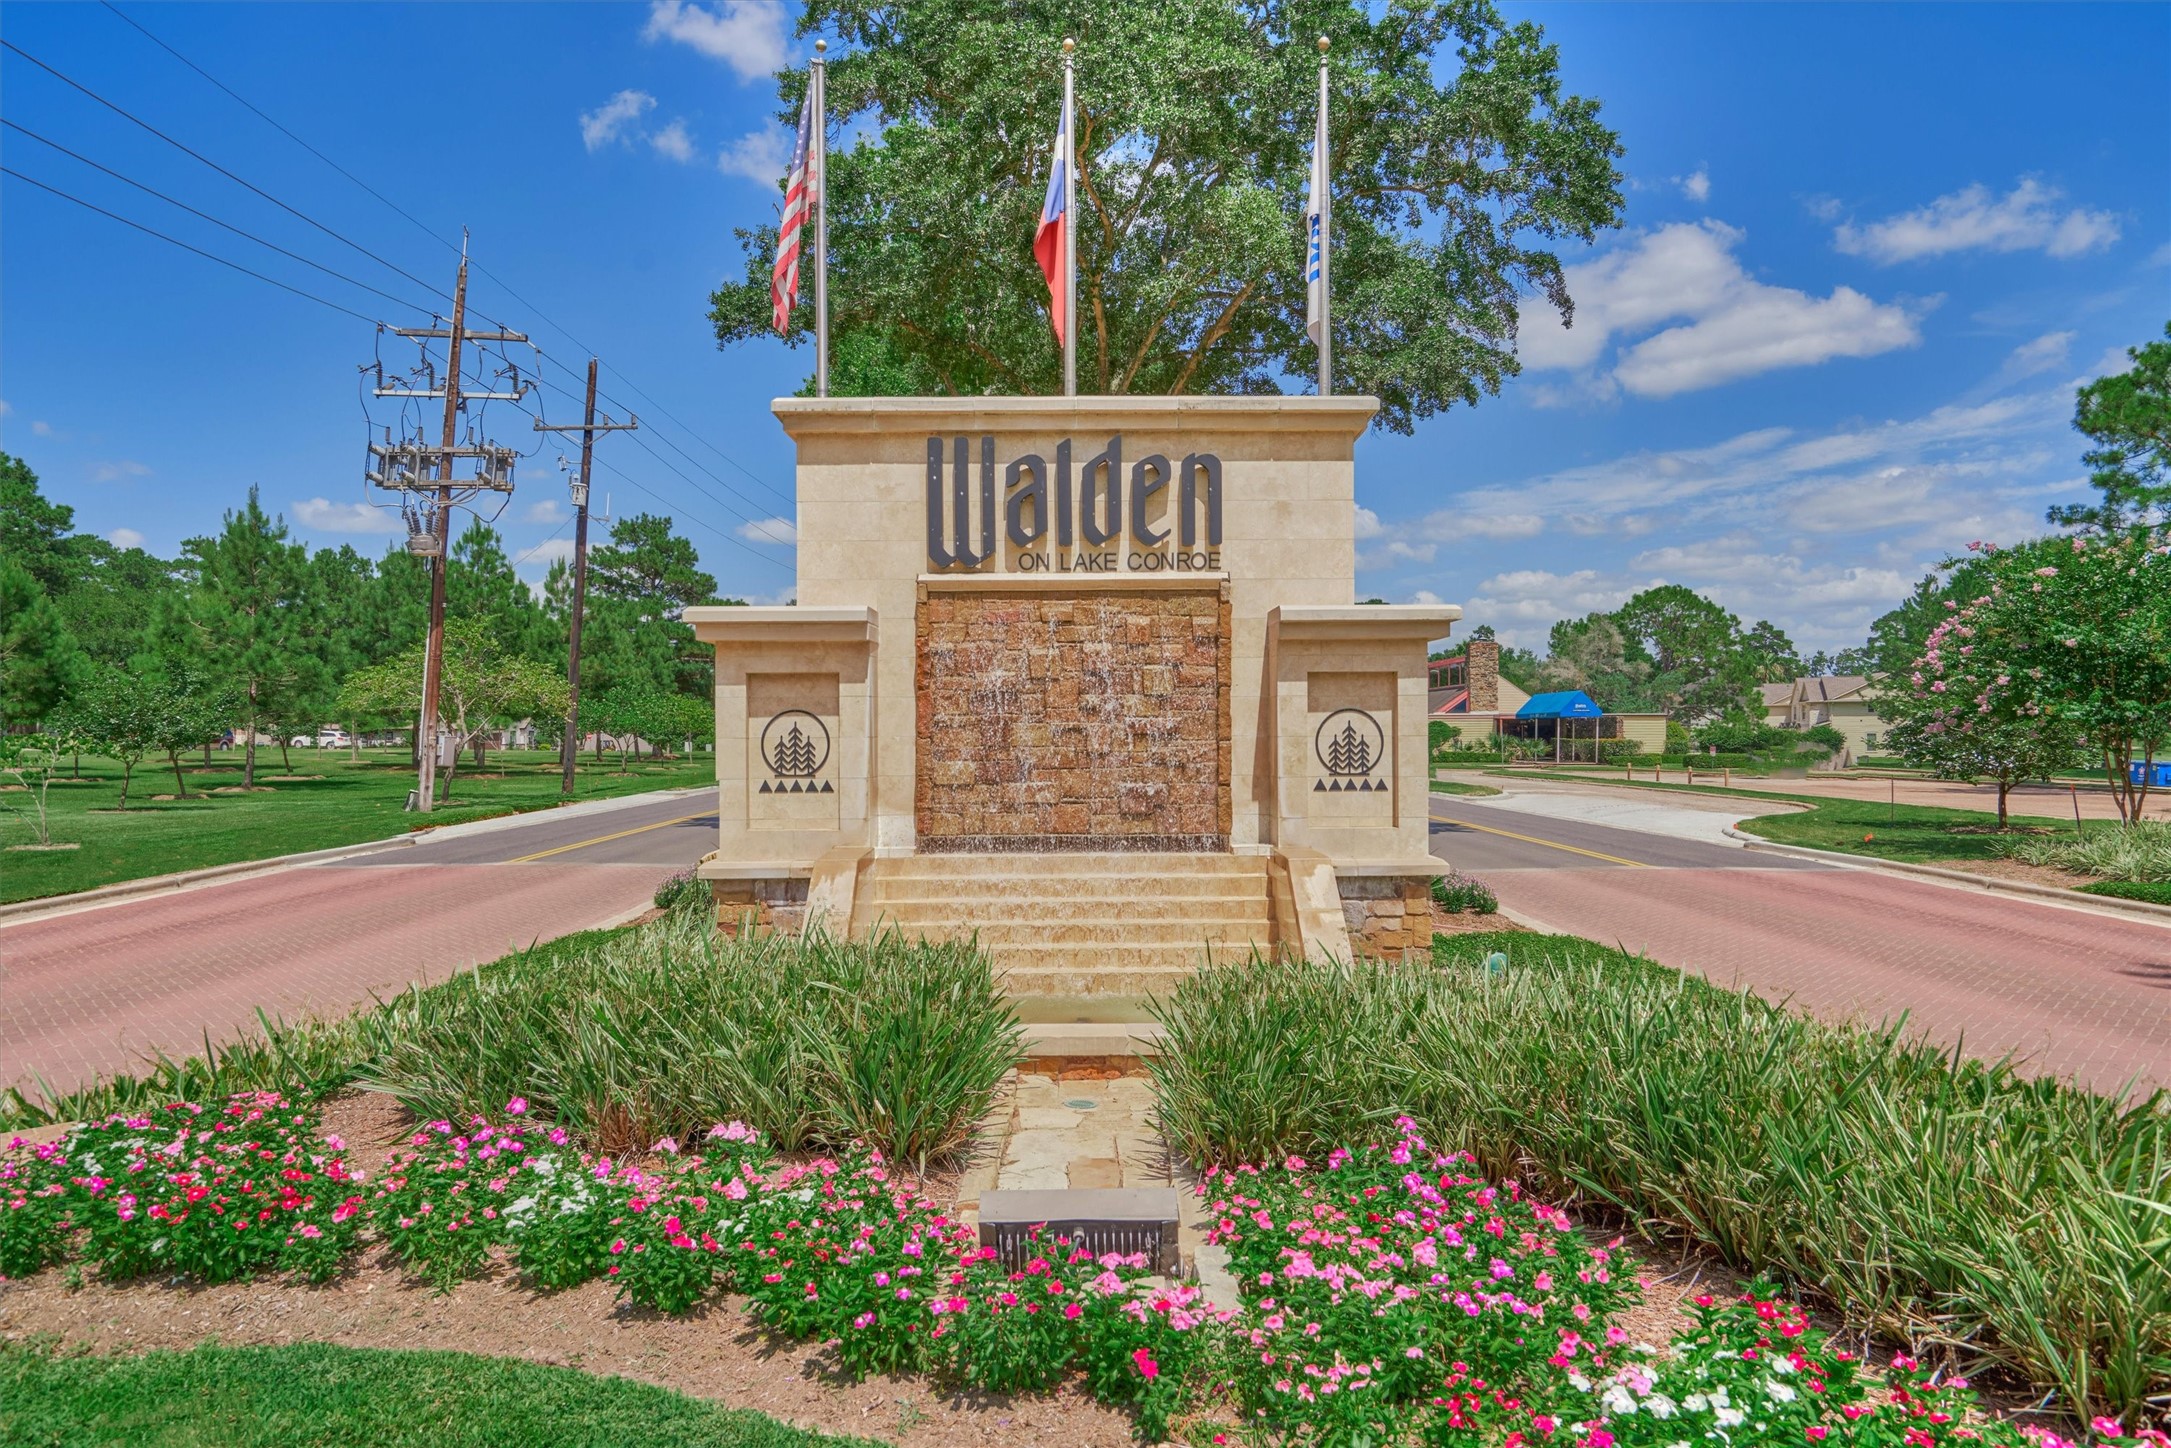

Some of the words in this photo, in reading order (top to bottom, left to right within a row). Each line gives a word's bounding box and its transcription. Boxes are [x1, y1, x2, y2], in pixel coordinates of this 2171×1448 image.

[927, 435, 1222, 568] Walden
[1018, 552, 1050, 571] ON
[1060, 552, 1118, 571] LAKE
[1127, 551, 1221, 571] CONROE
